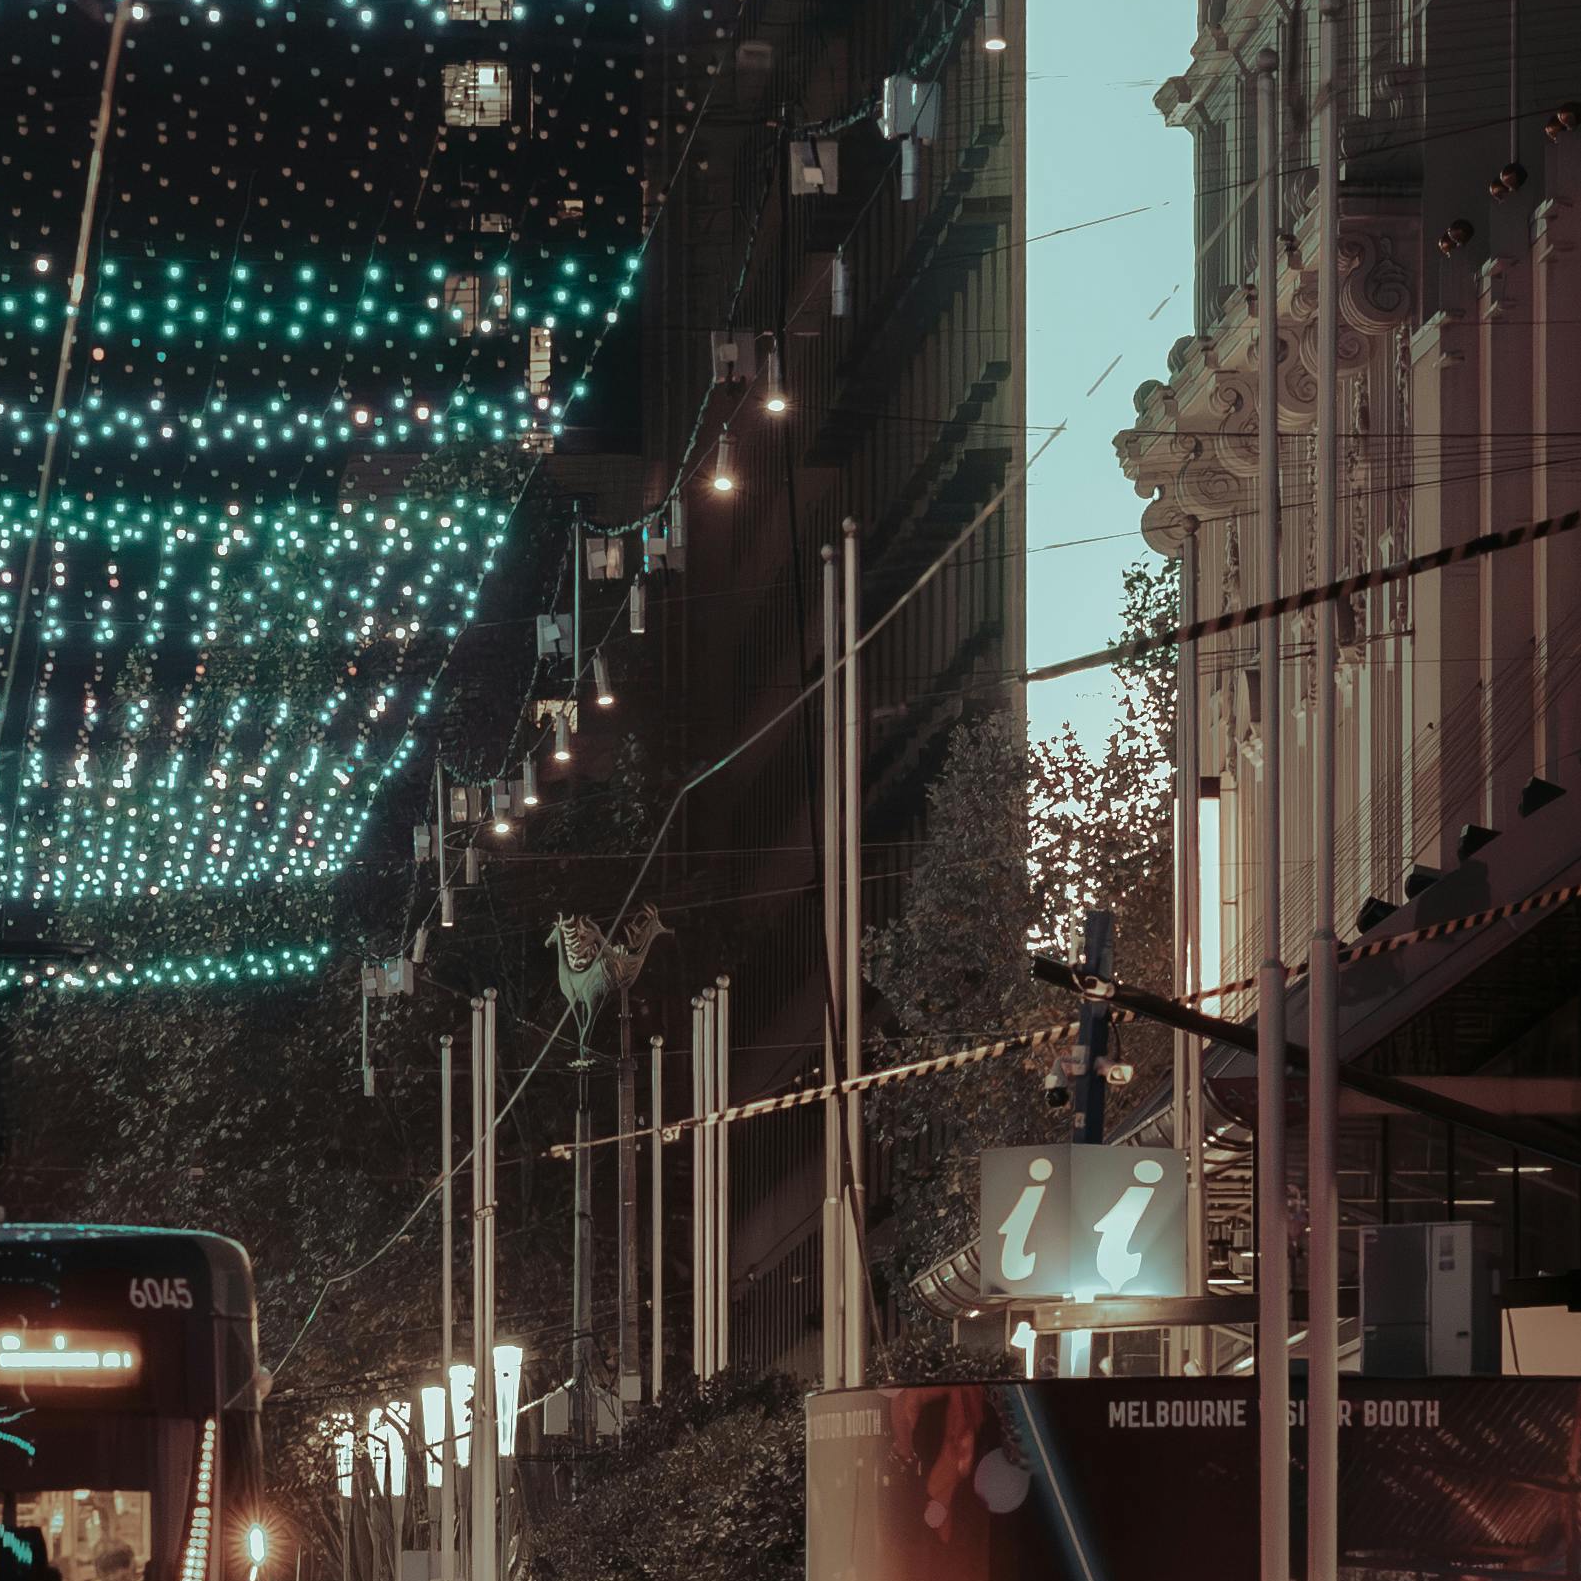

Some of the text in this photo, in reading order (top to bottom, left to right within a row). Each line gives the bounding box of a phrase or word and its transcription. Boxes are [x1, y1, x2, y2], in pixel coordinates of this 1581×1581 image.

[129, 1277, 193, 1309] 6045
[1108, 1400, 1247, 1427] MELBOURNE
[1363, 1400, 1440, 1427] BOOTH
